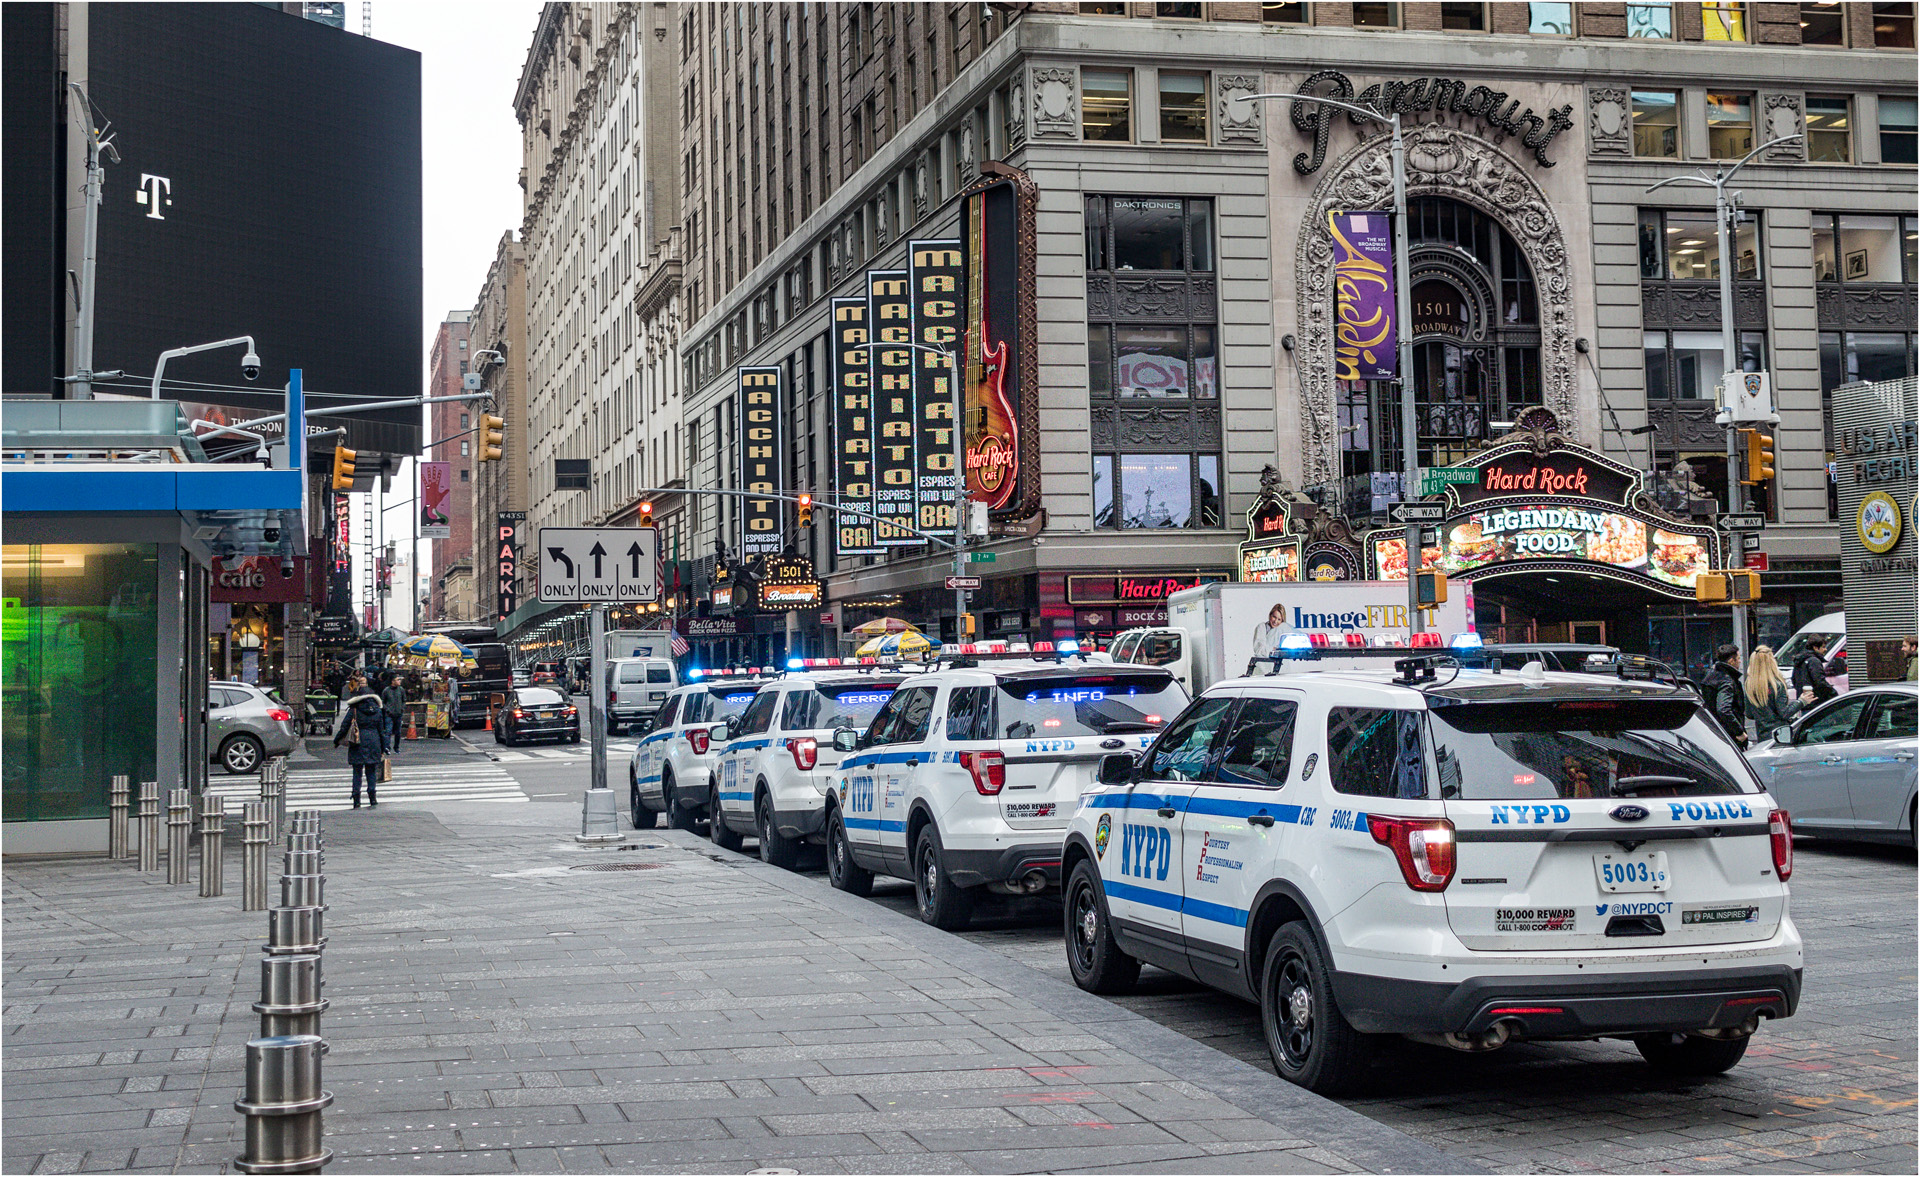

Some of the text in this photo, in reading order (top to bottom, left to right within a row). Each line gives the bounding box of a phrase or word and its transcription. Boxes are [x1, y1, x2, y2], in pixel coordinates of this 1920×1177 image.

[1291, 70, 1574, 174] Paramount
[1356, 113, 1504, 145] BULDING
[136, 173, 172, 220] T
[1114, 201, 1181, 209] DAKTRONICS
[1417, 303, 1451, 316] 1501
[915, 250, 962, 471] MACCHIATO
[873, 280, 912, 485] MACCHIATO
[836, 306, 870, 498] MACCHIATO
[305, 425, 328, 435] TERS
[742, 373, 777, 531] MACCHIATO
[967, 444, 1013, 470] Hard Rock
[920, 475, 965, 488] ESPRES
[983, 471, 998, 480] CAFE
[1432, 469, 1476, 484] Broadway
[1486, 467, 1588, 494] Hard Rock
[1422, 481, 1428, 493] W
[1430, 480, 1437, 492] 43
[878, 490, 911, 500] ESPRES
[920, 490, 939, 501] AND
[878, 503, 895, 513] AND
[1397, 508, 1439, 518] ONE WAY
[841, 515, 857, 525] AND
[1481, 509, 1606, 535] LEGENDARY
[1723, 518, 1759, 526] ONE WAY
[841, 527, 871, 547] BA
[1515, 534, 1575, 553] FOOD
[745, 544, 759, 553] AND
[1249, 553, 1289, 572] LEGENDARY
[219, 566, 266, 588] café
[500, 526, 514, 621] PARKI
[780, 566, 801, 577] 1501
[1309, 567, 1344, 579] Hard Rock
[544, 585, 651, 596] ONLY ONLY ONLY
[1121, 578, 1203, 598] Hard Ro
[767, 590, 814, 602] Broadway
[1125, 612, 1155, 621] ROCK
[1293, 604, 1441, 634] ImageFIRT
[689, 619, 736, 629] Bella Vita
[838, 694, 891, 704] TERRO
[1052, 691, 1104, 703] INFO
[1026, 739, 1075, 753] NYPD
[852, 776, 873, 812] NYPD
[1300, 806, 1317, 827] CRC
[1490, 799, 1753, 824] NYPD POLICE
[1619, 807, 1641, 818] Ford
[1204, 831, 1230, 850] COURTESY
[1121, 822, 1171, 882] NYPD
[1196, 864, 1219, 884] RESPECT
[1496, 908, 1575, 920] $10,000 REWARD
[1611, 902, 1673, 916] @NYPDCT
[1702, 910, 1746, 920] PAL INSPIRES
[1513, 923, 1531, 931] 1-800
